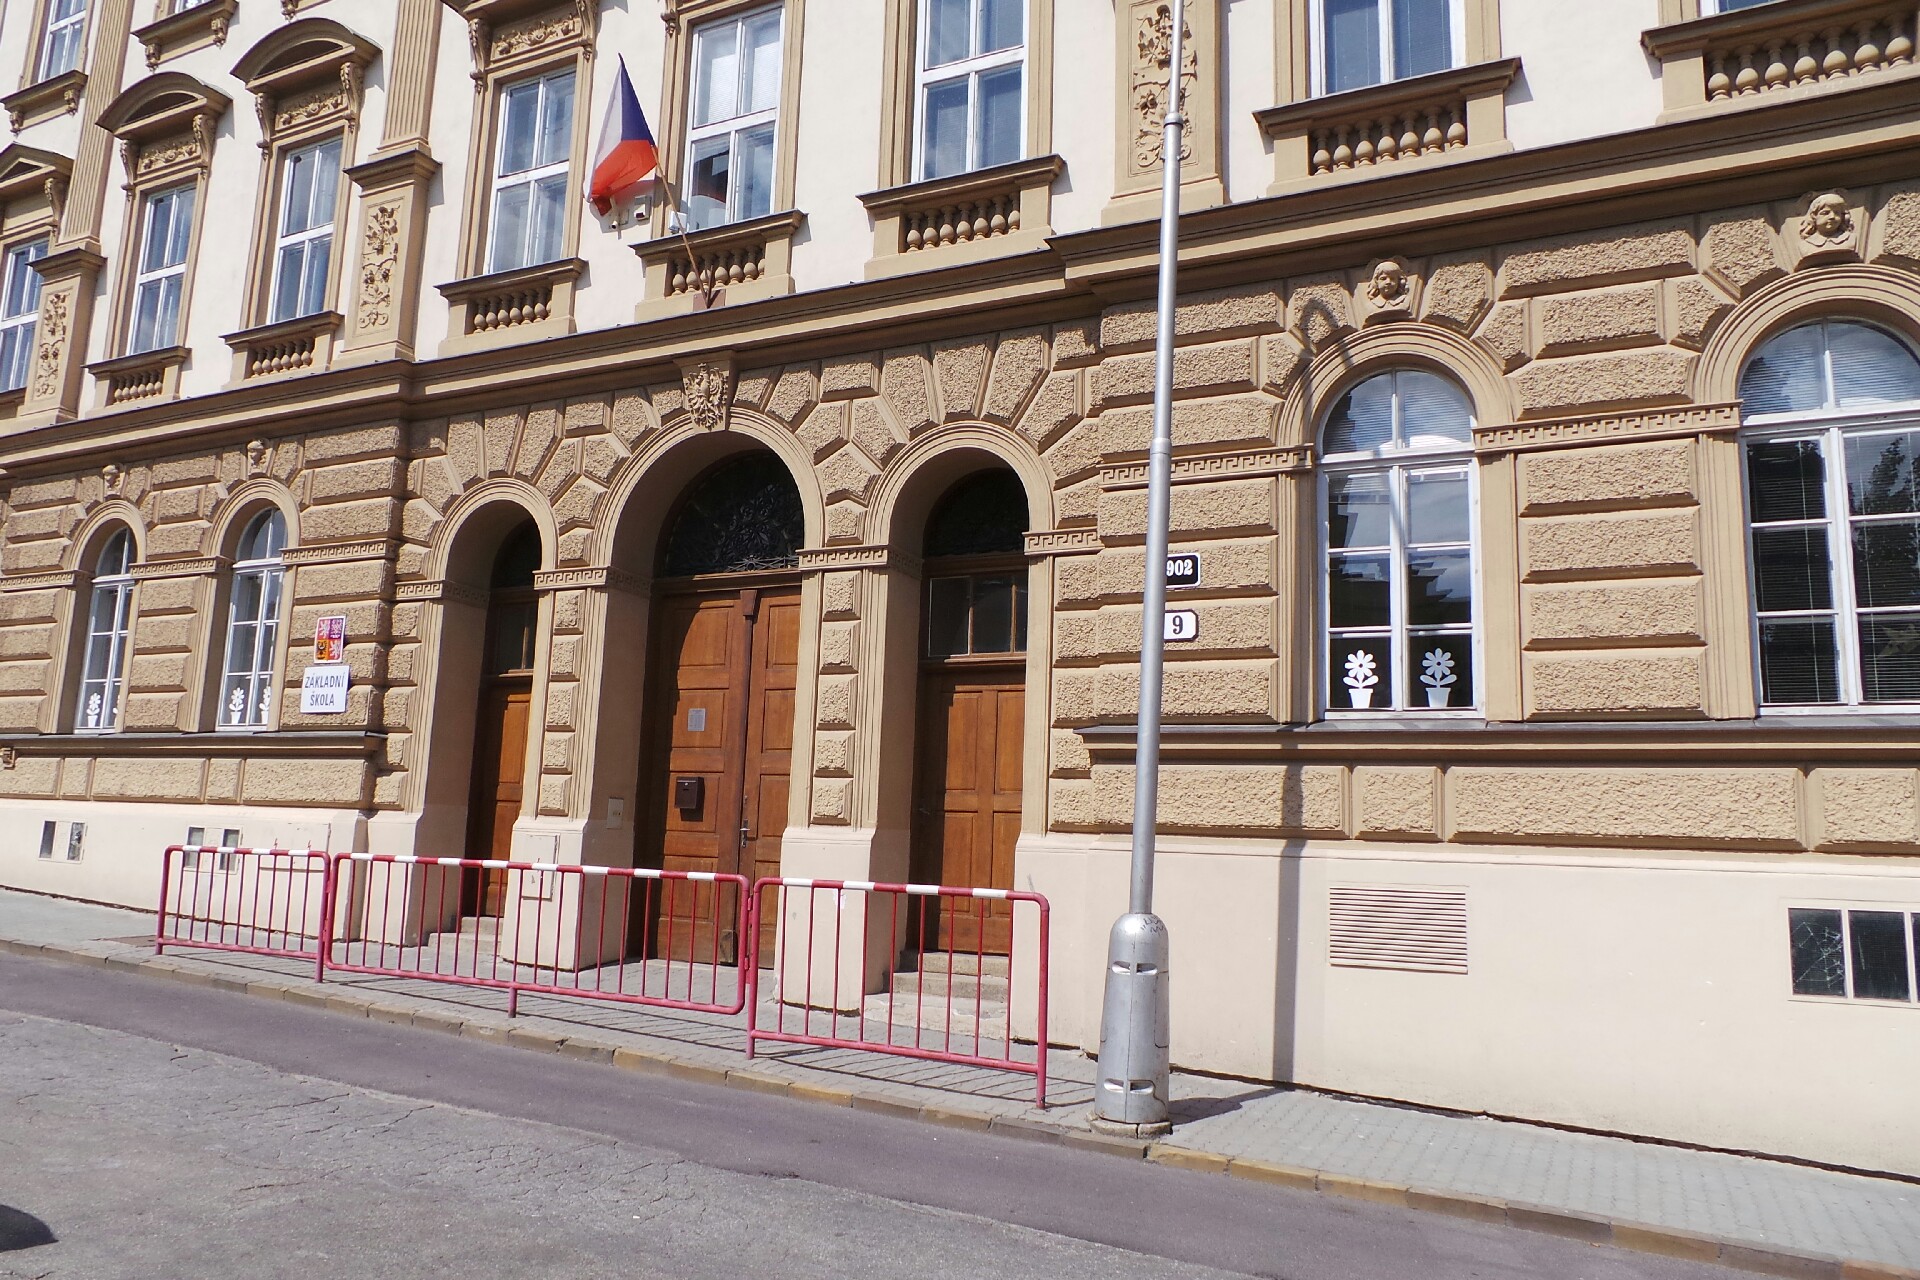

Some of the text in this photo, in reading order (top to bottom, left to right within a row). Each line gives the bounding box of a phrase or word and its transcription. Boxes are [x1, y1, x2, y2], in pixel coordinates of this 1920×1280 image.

[1166, 559, 1193, 577] 902
[1172, 615, 1184, 635] 9
[304, 672, 345, 688] ZÁKLADNÍ
[310, 691, 335, 706] ŠKOLA
